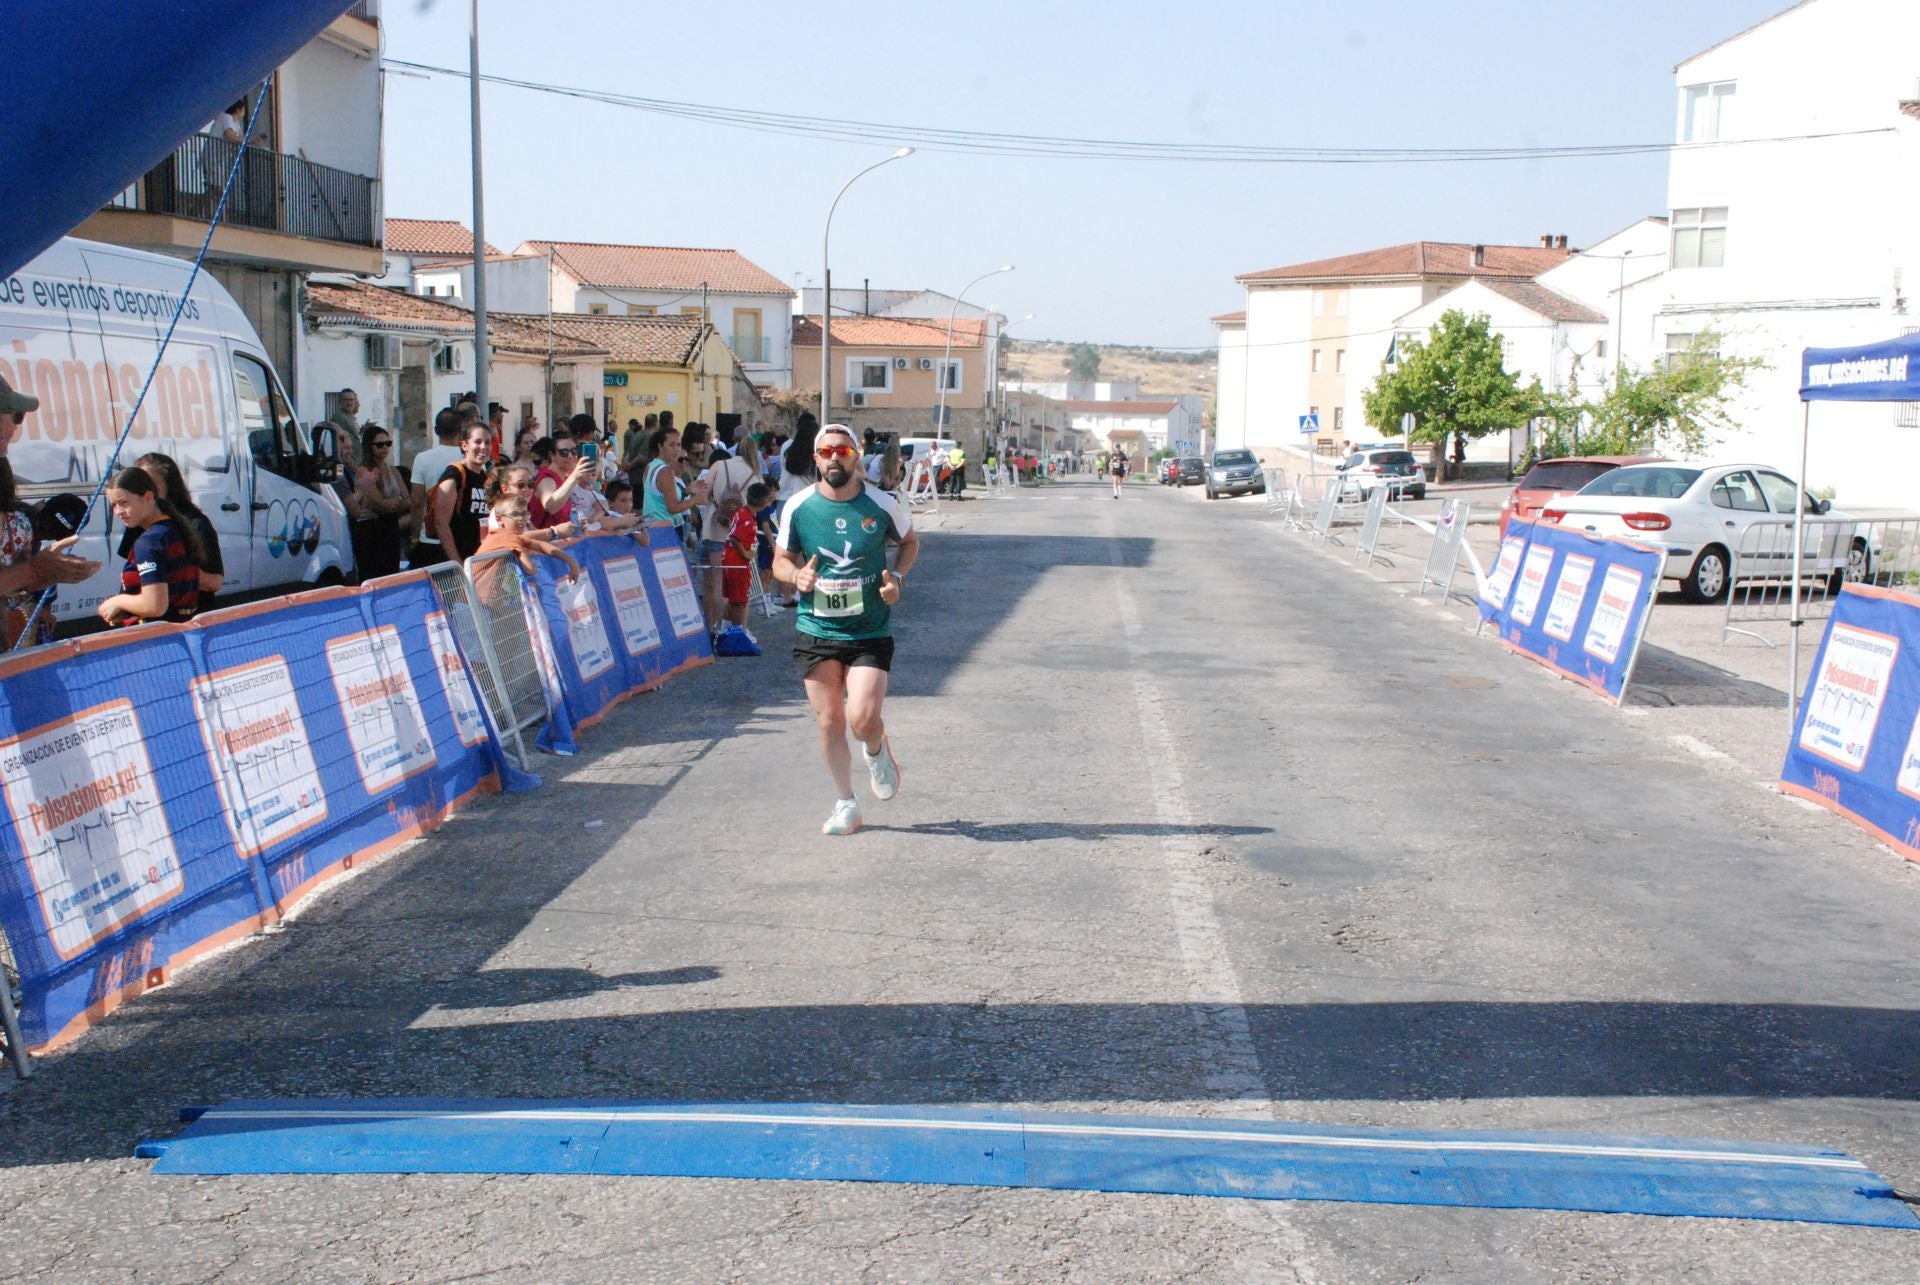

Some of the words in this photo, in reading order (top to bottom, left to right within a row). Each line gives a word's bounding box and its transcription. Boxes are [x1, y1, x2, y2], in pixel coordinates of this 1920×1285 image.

[33, 277, 110, 311] eventos
[113, 283, 200, 321] deportivos
[825, 593, 848, 609] 181
[3, 739, 56, 774] ORGANIZACIÓN
[55, 739, 66, 754] DE
[65, 727, 97, 751] EVENTOS
[27, 761, 144, 837] Pulsaciones.net
